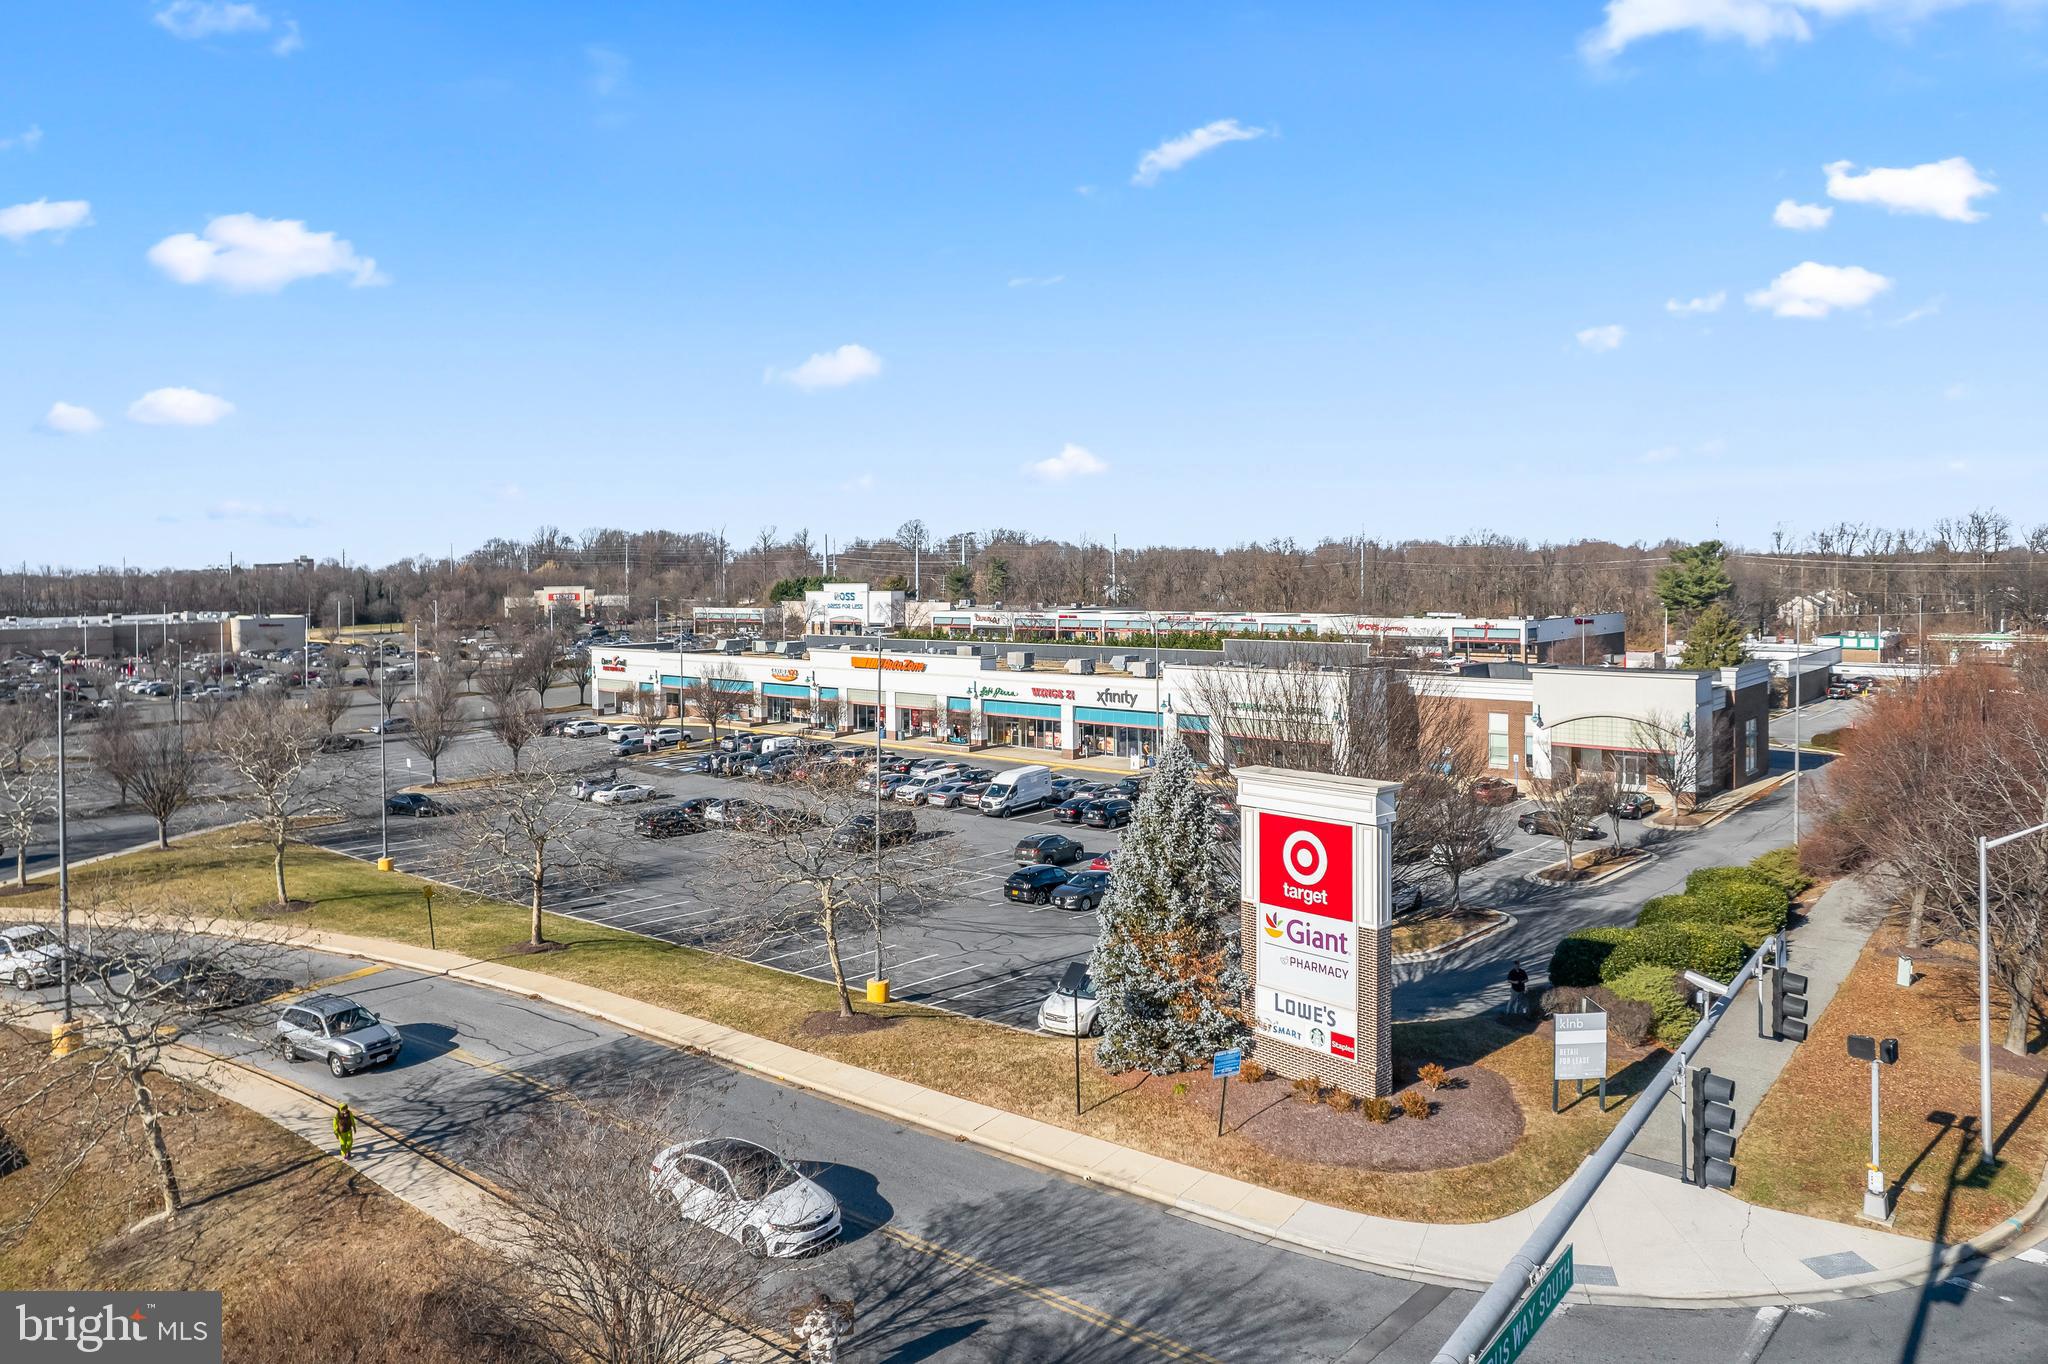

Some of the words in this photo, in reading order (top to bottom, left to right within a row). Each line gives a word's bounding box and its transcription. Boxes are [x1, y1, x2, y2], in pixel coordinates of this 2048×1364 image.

[1031, 687, 1064, 699] WINGS
[1097, 688, 1138, 708] xfinity
[1282, 882, 1328, 905] target
[1286, 919, 1348, 955] Giant
[1289, 956, 1349, 980] PHARMACY
[1274, 992, 1336, 1027] LOWE'S
[1559, 1018, 1584, 1029] klnb
[1487, 1337, 1510, 1364] US
[1513, 1302, 1536, 1351] WAY
[1539, 1257, 1571, 1318] SOUTH
